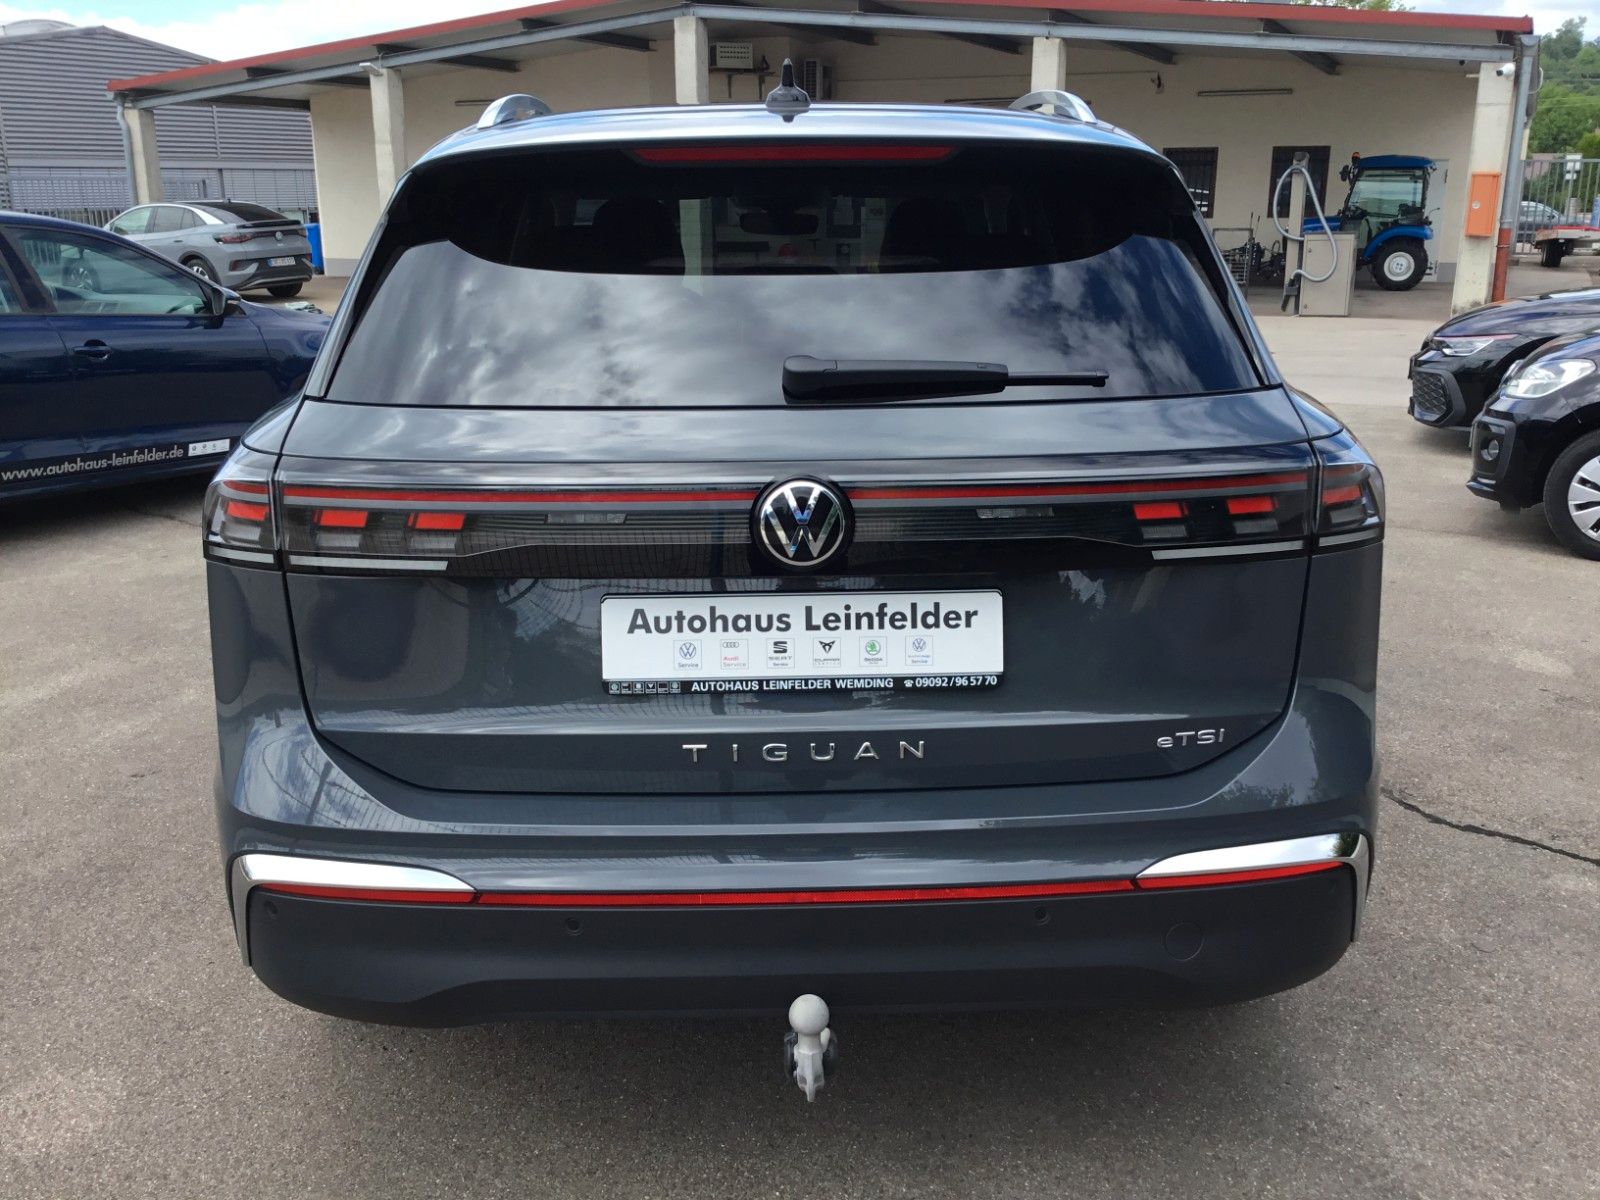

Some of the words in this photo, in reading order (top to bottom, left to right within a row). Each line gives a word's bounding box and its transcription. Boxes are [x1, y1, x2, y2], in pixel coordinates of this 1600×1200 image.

[1, 445, 184, 481] www.autohaus-leinfelder.de
[627, 606, 792, 634] Autohaus
[804, 602, 978, 631] Leinfelder
[691, 681, 759, 692] AUTOHAUS
[763, 680, 831, 690] LEINFELDER
[835, 678, 894, 689] WEMDING
[1156, 728, 1226, 748] eTSI
[682, 740, 926, 763] TIGUAN
